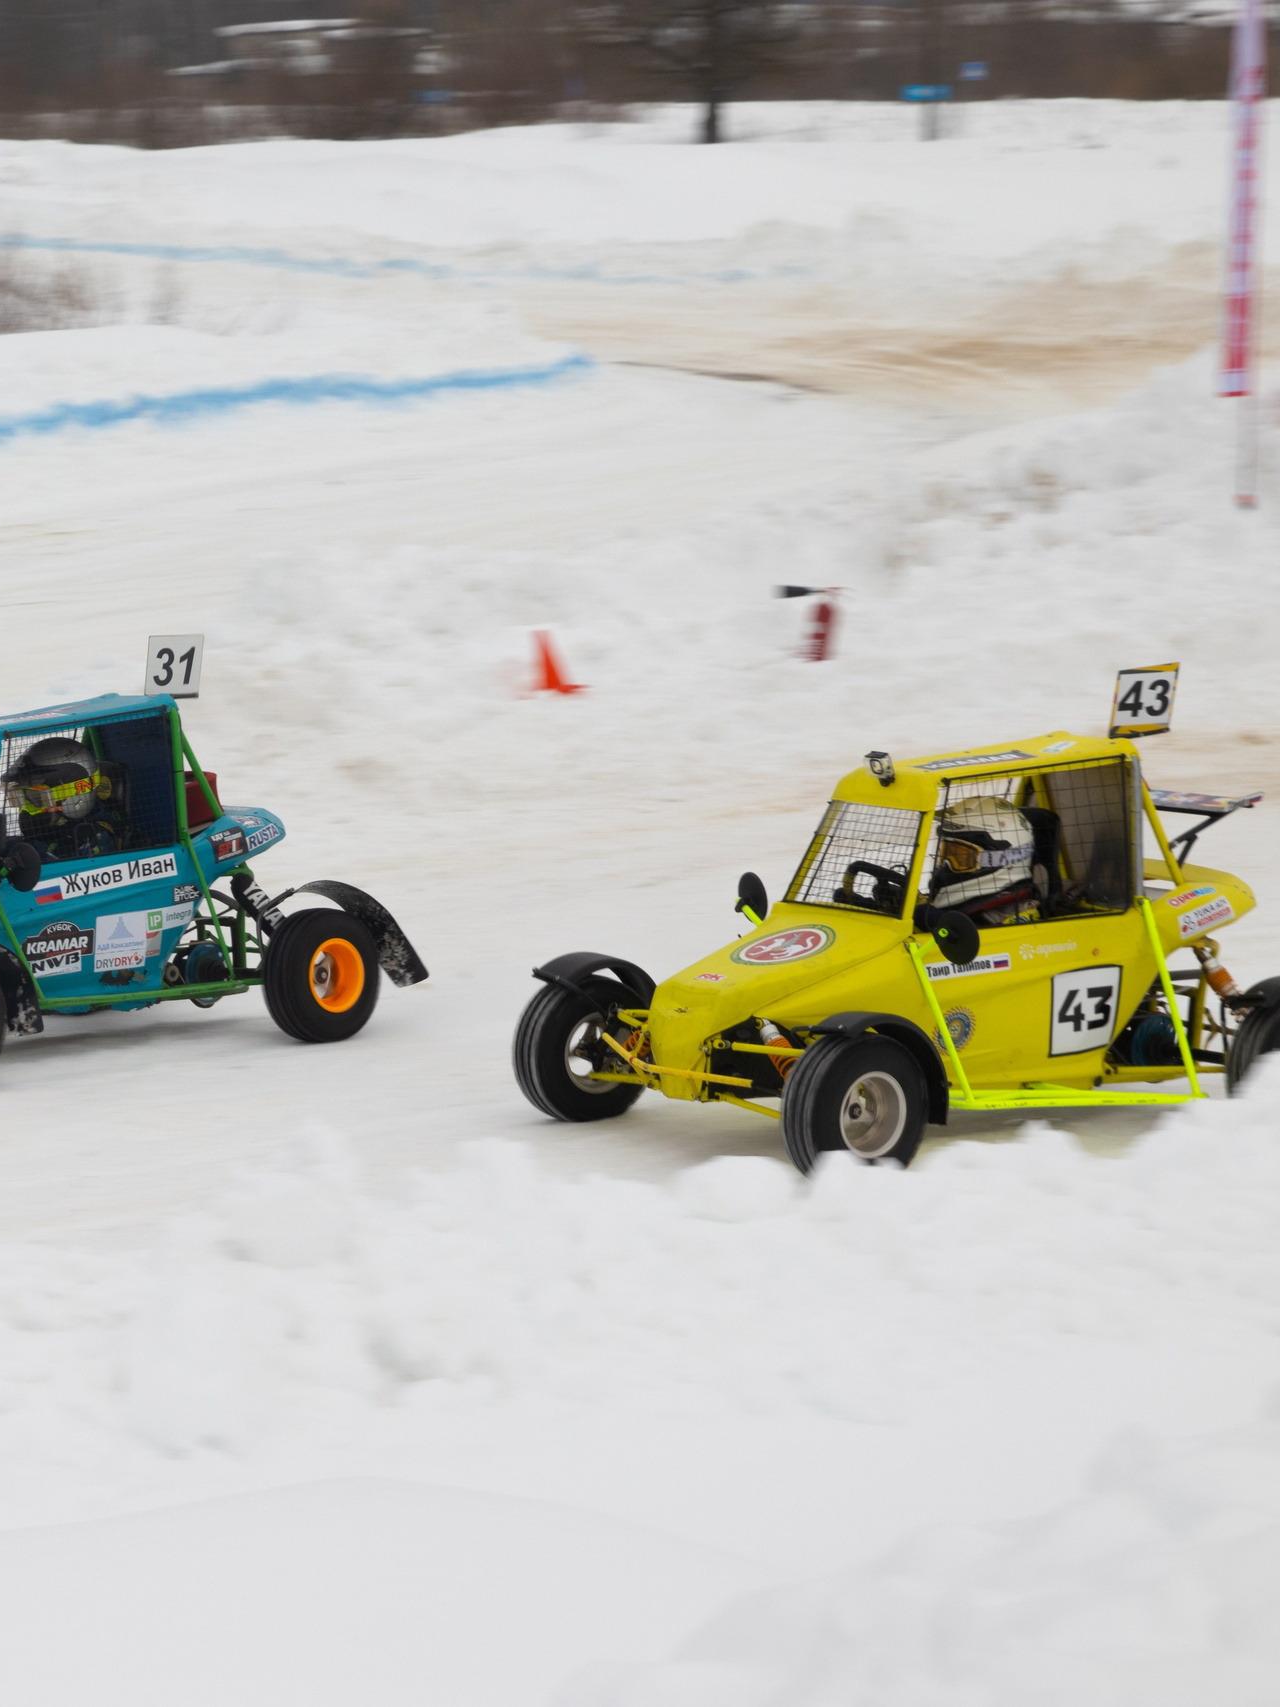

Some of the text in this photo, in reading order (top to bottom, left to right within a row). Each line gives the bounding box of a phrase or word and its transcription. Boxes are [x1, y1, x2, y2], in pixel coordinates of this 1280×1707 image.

[153, 646, 195, 686] 31
[1118, 679, 1170, 718] 43
[248, 825, 279, 850] RUSTA
[62, 858, 175, 895] Жуков Иван
[47, 924, 72, 934] КУБОК
[150, 909, 191, 927] IP integra
[26, 936, 89, 955] KRAMAR
[32, 952, 80, 974] NWB
[96, 956, 133, 969] DRYDRY
[926, 959, 991, 978] Таир Талипов
[1058, 986, 1113, 1032] 43
